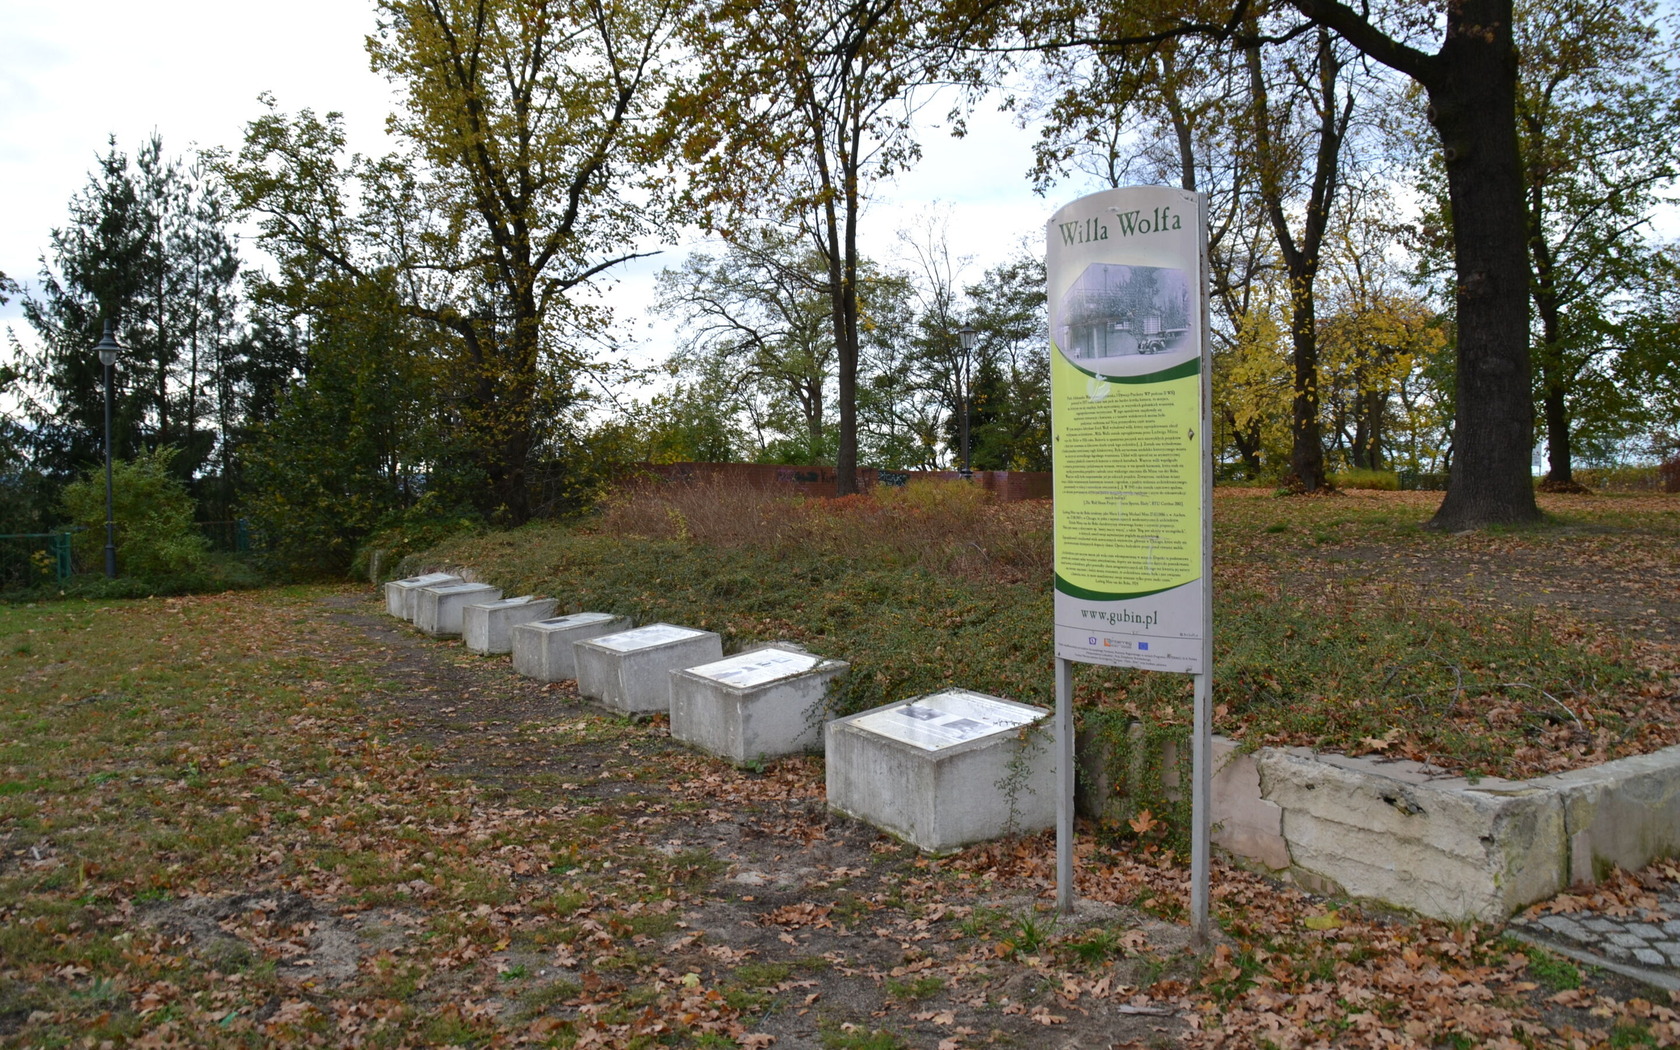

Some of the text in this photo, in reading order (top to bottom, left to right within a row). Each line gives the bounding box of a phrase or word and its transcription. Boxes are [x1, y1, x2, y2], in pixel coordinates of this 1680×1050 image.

[1059, 206, 1182, 247] Willa Wolfa
[1080, 608, 1158, 630] www.gubin.pl
